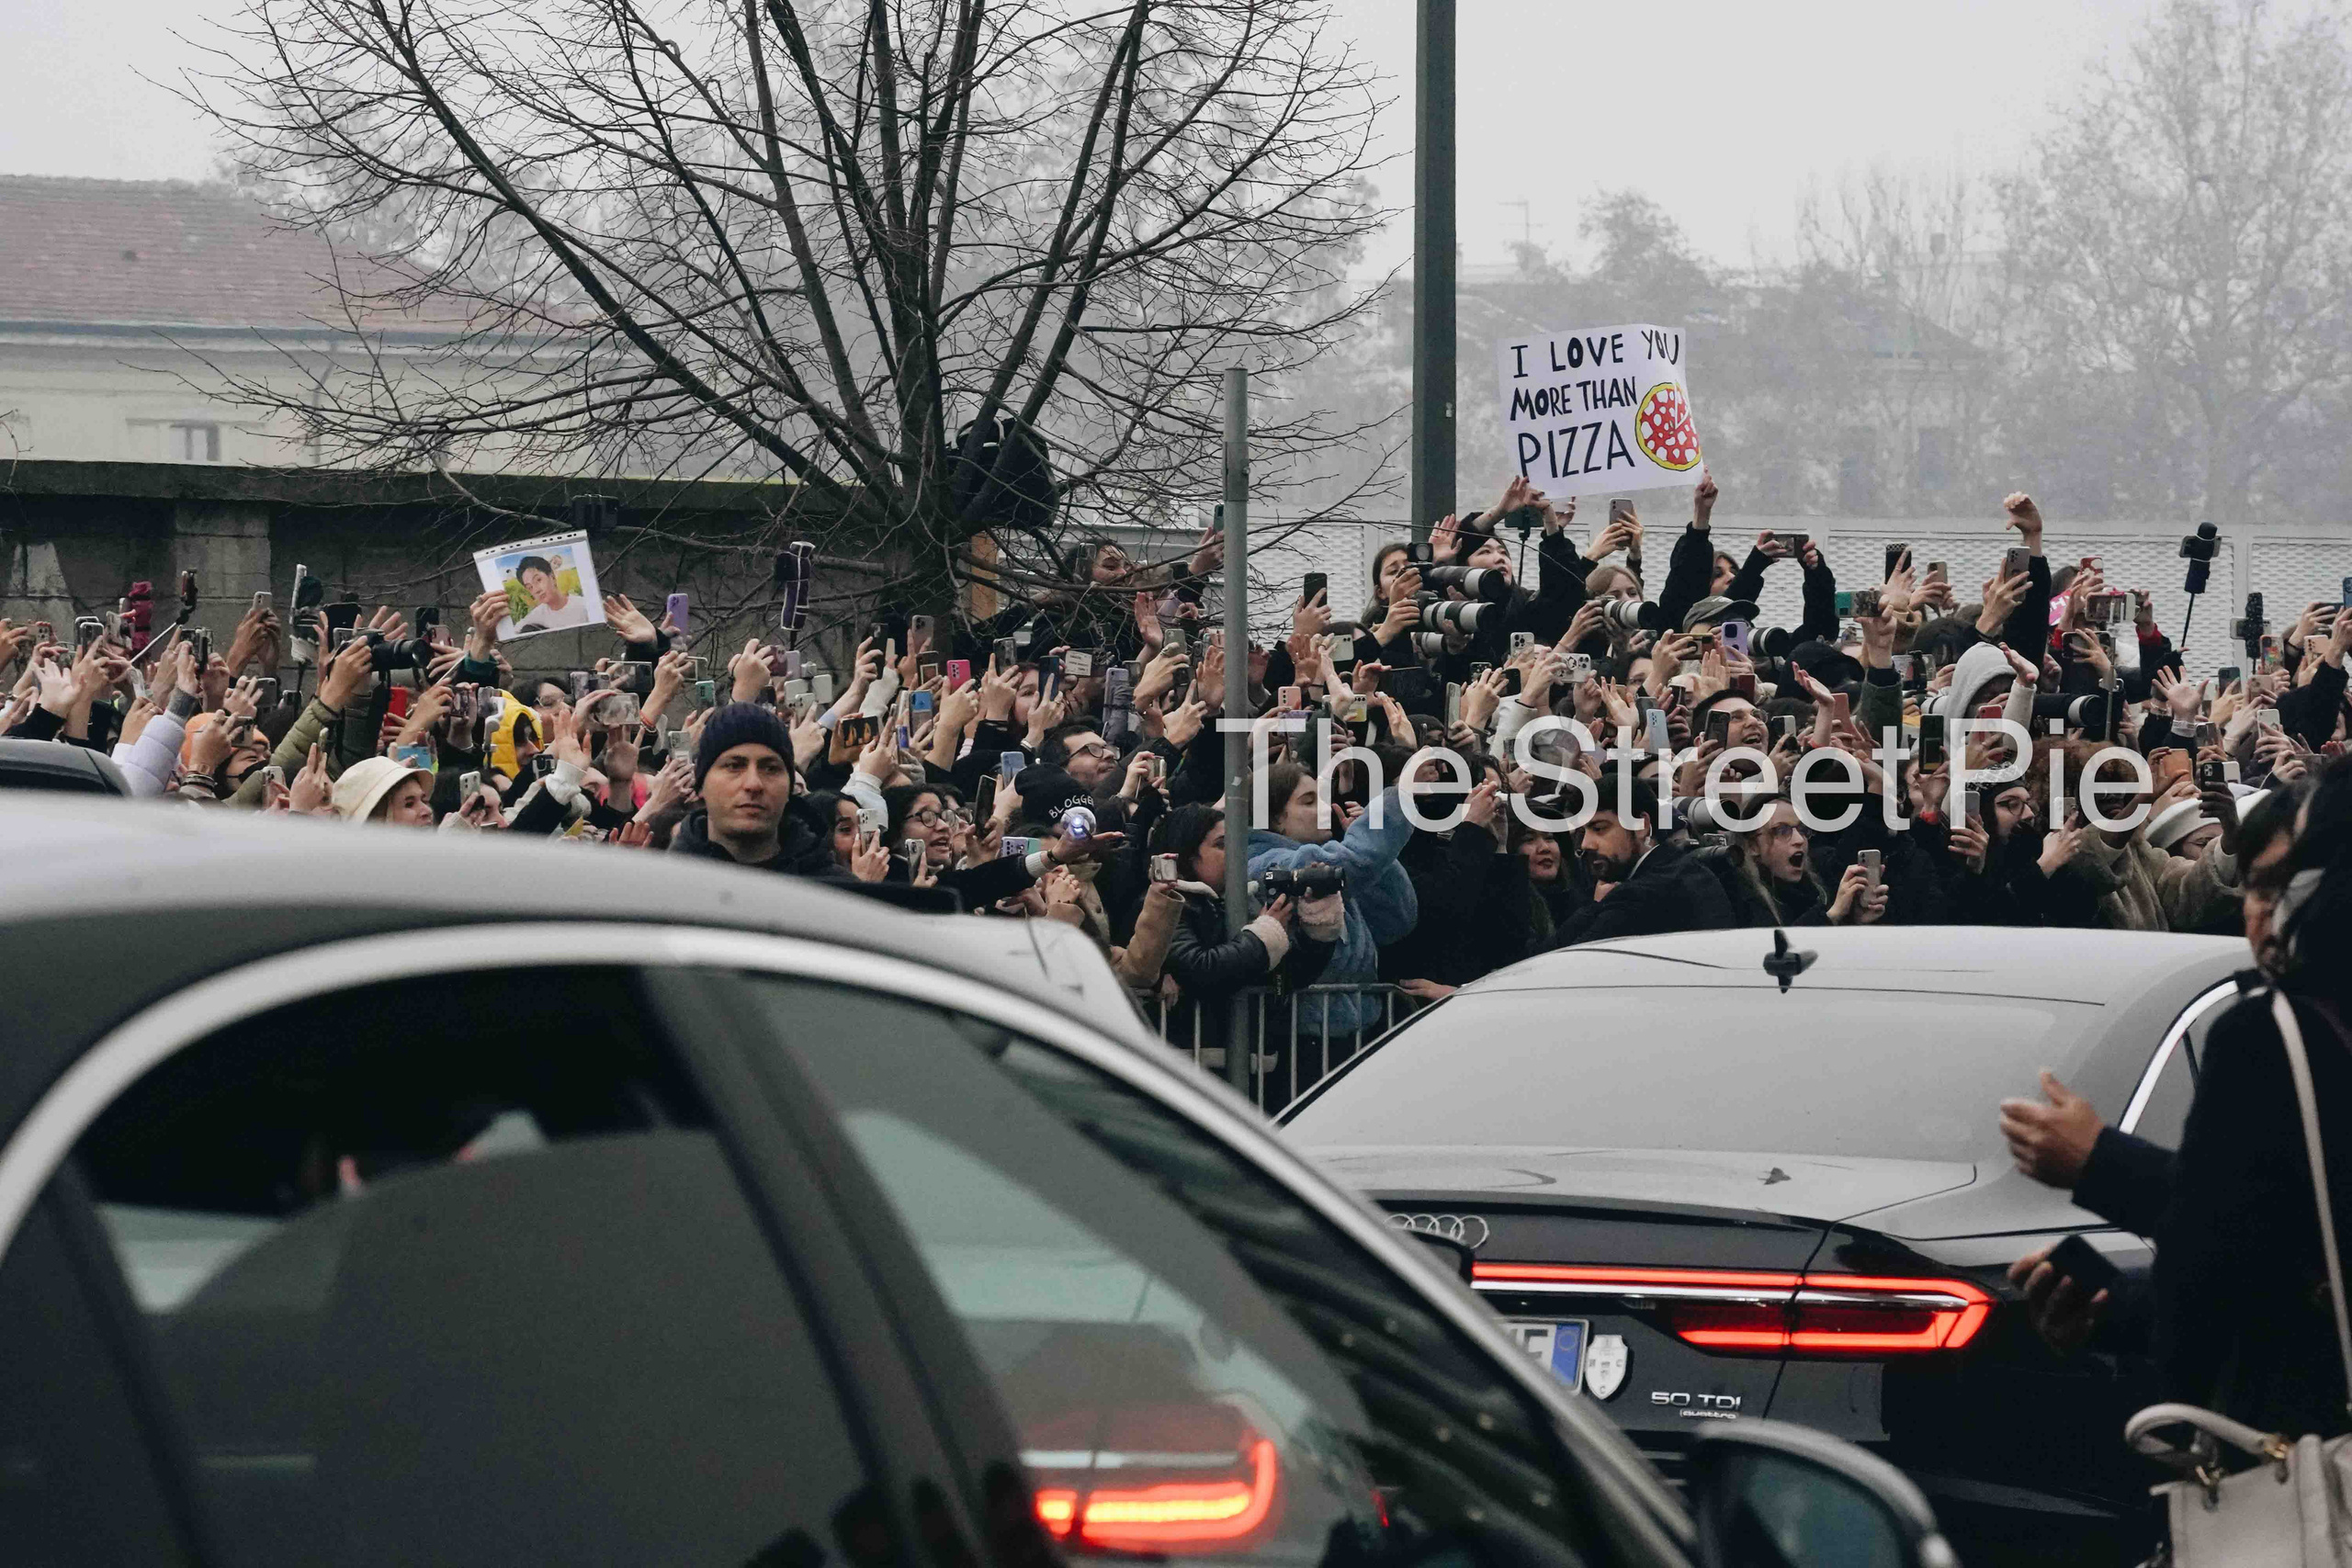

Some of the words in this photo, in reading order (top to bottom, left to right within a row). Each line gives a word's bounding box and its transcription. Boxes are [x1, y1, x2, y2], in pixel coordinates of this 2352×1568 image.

[1510, 344, 1529, 378] I
[1550, 333, 1623, 372] LOVE
[1641, 330, 1679, 365] YOU
[1510, 384, 1572, 422] MORE
[1577, 376, 1638, 412] THAN
[1518, 419, 1635, 479] PIZZA
[1651, 1391, 1690, 1406] 50
[1697, 1393, 1742, 1410] TDI
